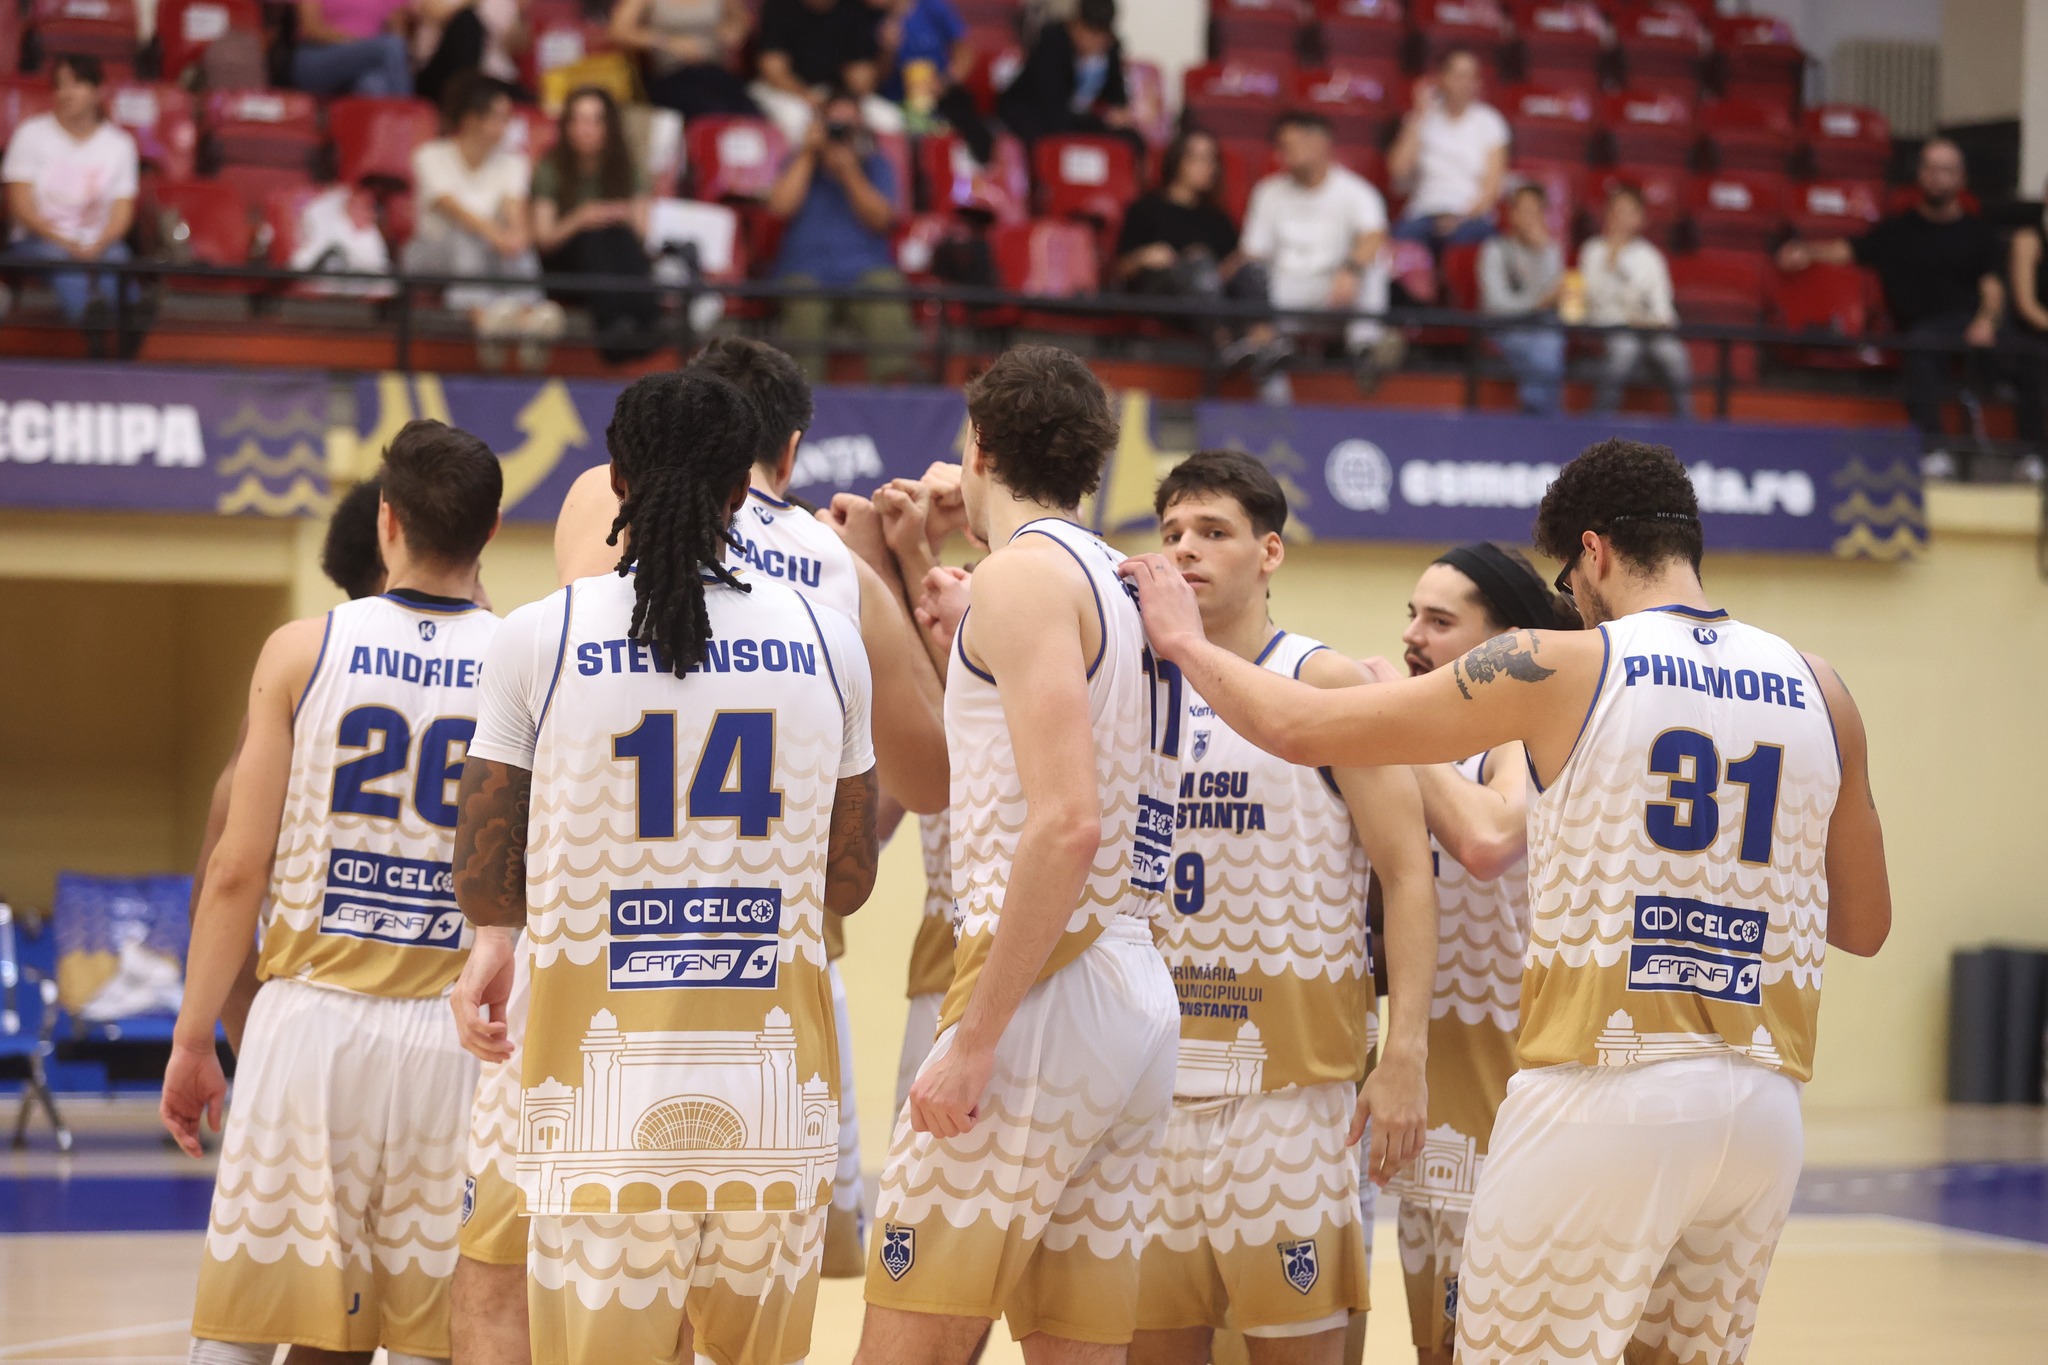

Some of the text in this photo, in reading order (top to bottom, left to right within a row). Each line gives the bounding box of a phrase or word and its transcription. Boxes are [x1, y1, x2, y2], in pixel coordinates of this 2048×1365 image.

[0, 400, 206, 468] CHIPA
[349, 646, 484, 688] ANDRIE
[577, 639, 816, 676] STENSON
[1624, 654, 1806, 710] PHILMORE
[328, 703, 478, 831] 26
[611, 709, 786, 842] 14
[1199, 771, 1248, 798] CSU
[1644, 726, 1785, 867] 31
[1174, 852, 1205, 915] 9
[338, 907, 426, 932] CATENA
[683, 898, 774, 924] CELCO
[1686, 910, 1760, 943] CELCO
[629, 954, 731, 977] CATENA
[1170, 963, 1237, 982] RIMĂRIA
[1647, 959, 1729, 984] CATENA
